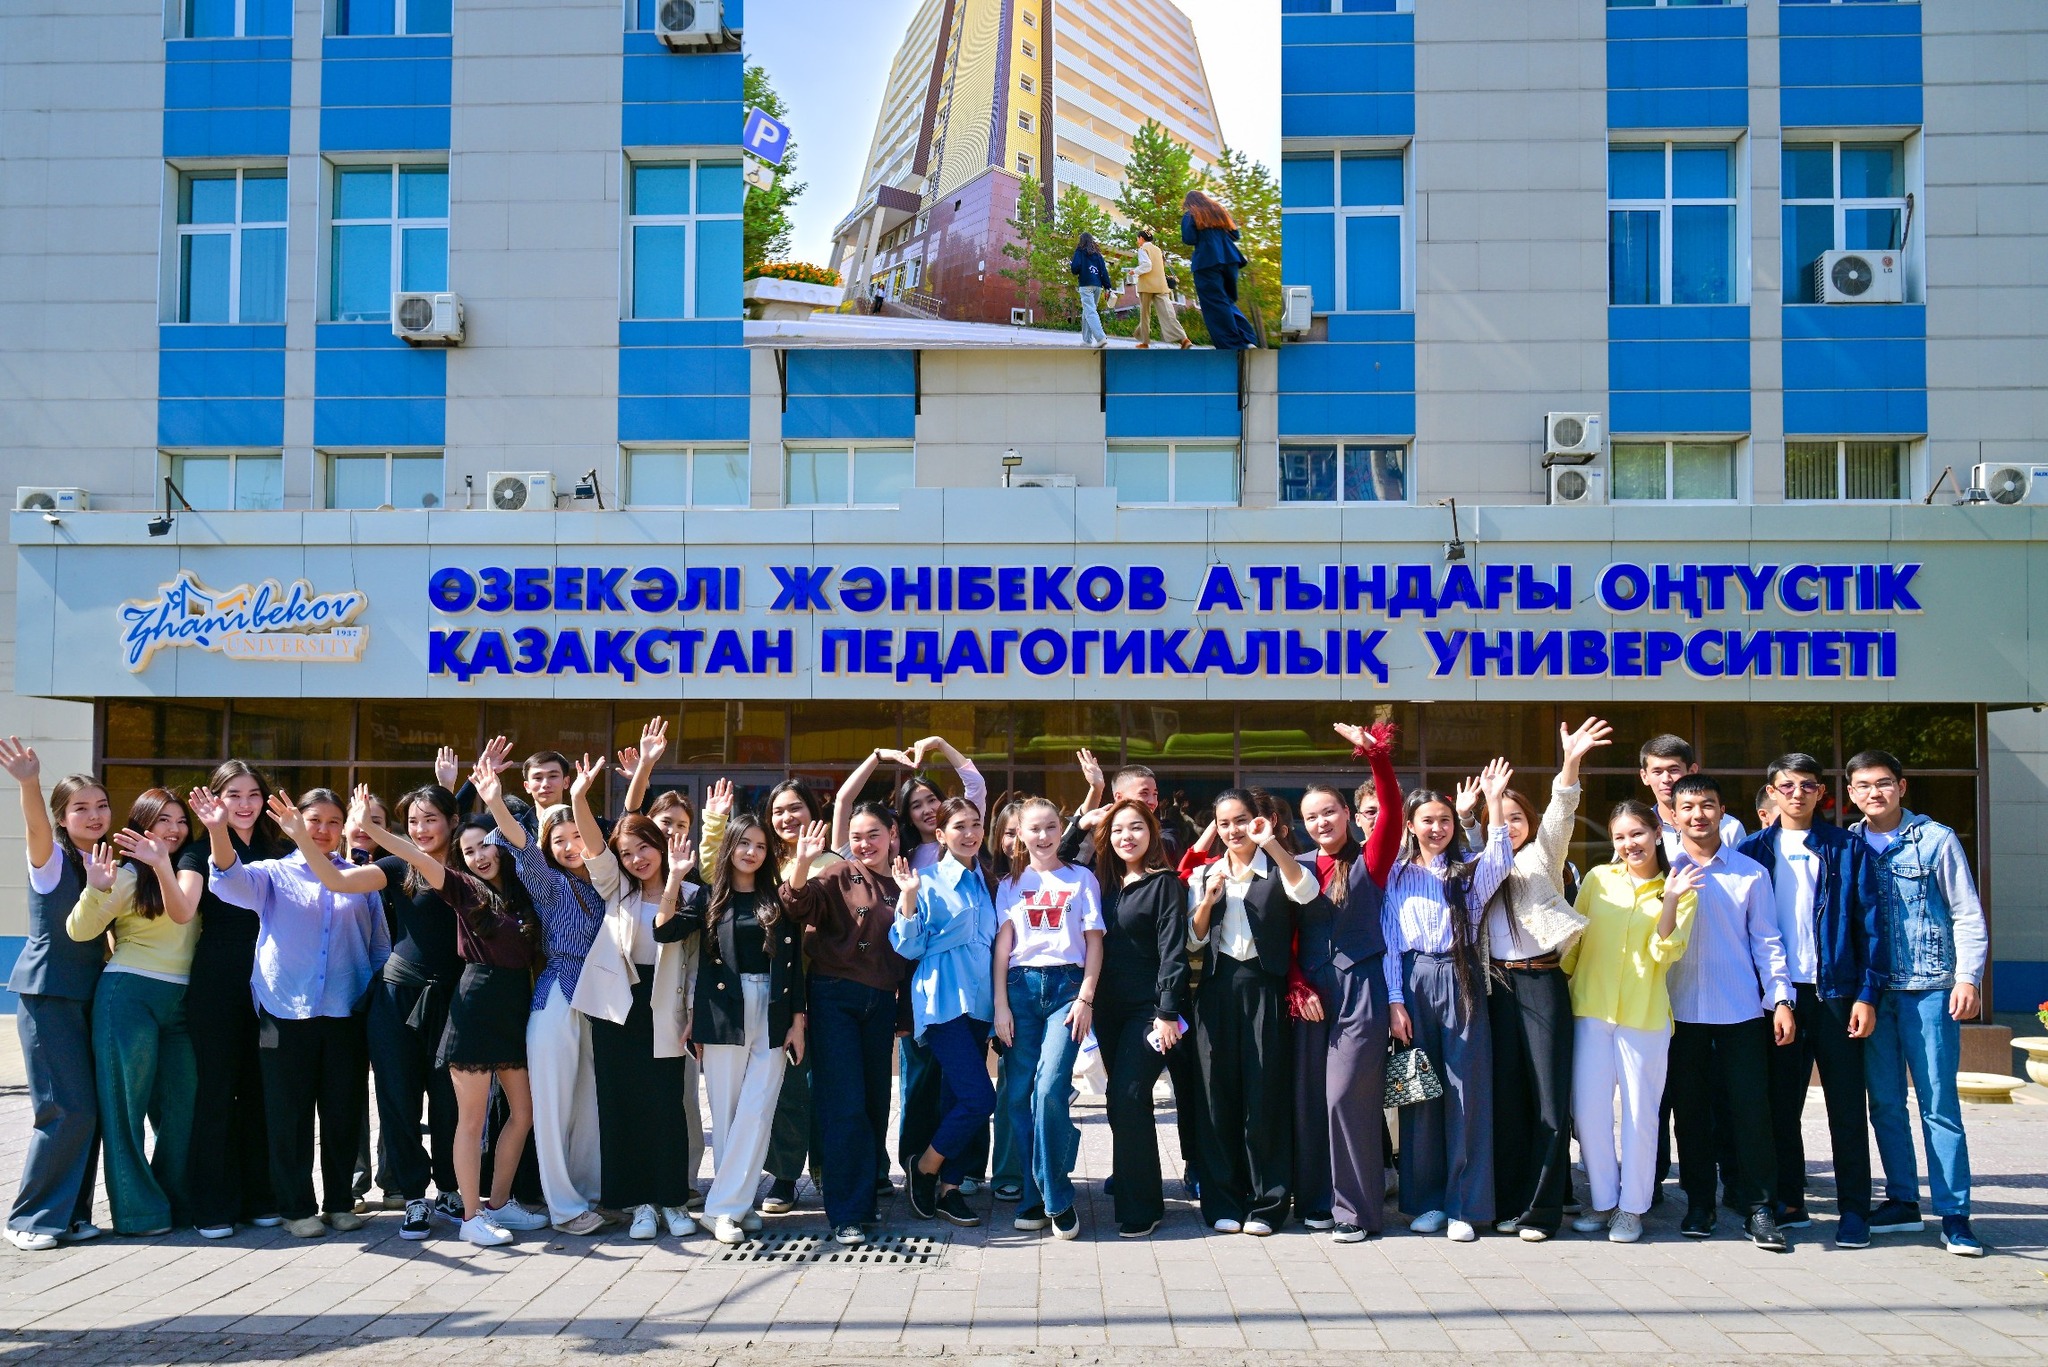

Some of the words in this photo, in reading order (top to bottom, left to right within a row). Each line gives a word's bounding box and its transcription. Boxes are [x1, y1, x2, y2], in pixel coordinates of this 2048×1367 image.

[751, 117, 780, 148] P
[428, 566, 741, 613] ӨЗБЕКӘЛІ
[769, 565, 1167, 612] ЖӘНІБЕКОВ
[1198, 563, 1571, 619] АТЫНДАҒЫ
[1599, 562, 1921, 619] ОҢТҮСТІК
[225, 636, 352, 654] UNIVERSITY
[335, 629, 358, 638] 1937
[428, 628, 793, 682] ҚАЗАҚСТАН
[821, 628, 1388, 683] ПЕДАГОГИКАЛЫҚ
[1423, 629, 1897, 677] УНИВЕРСИТЕТІ
